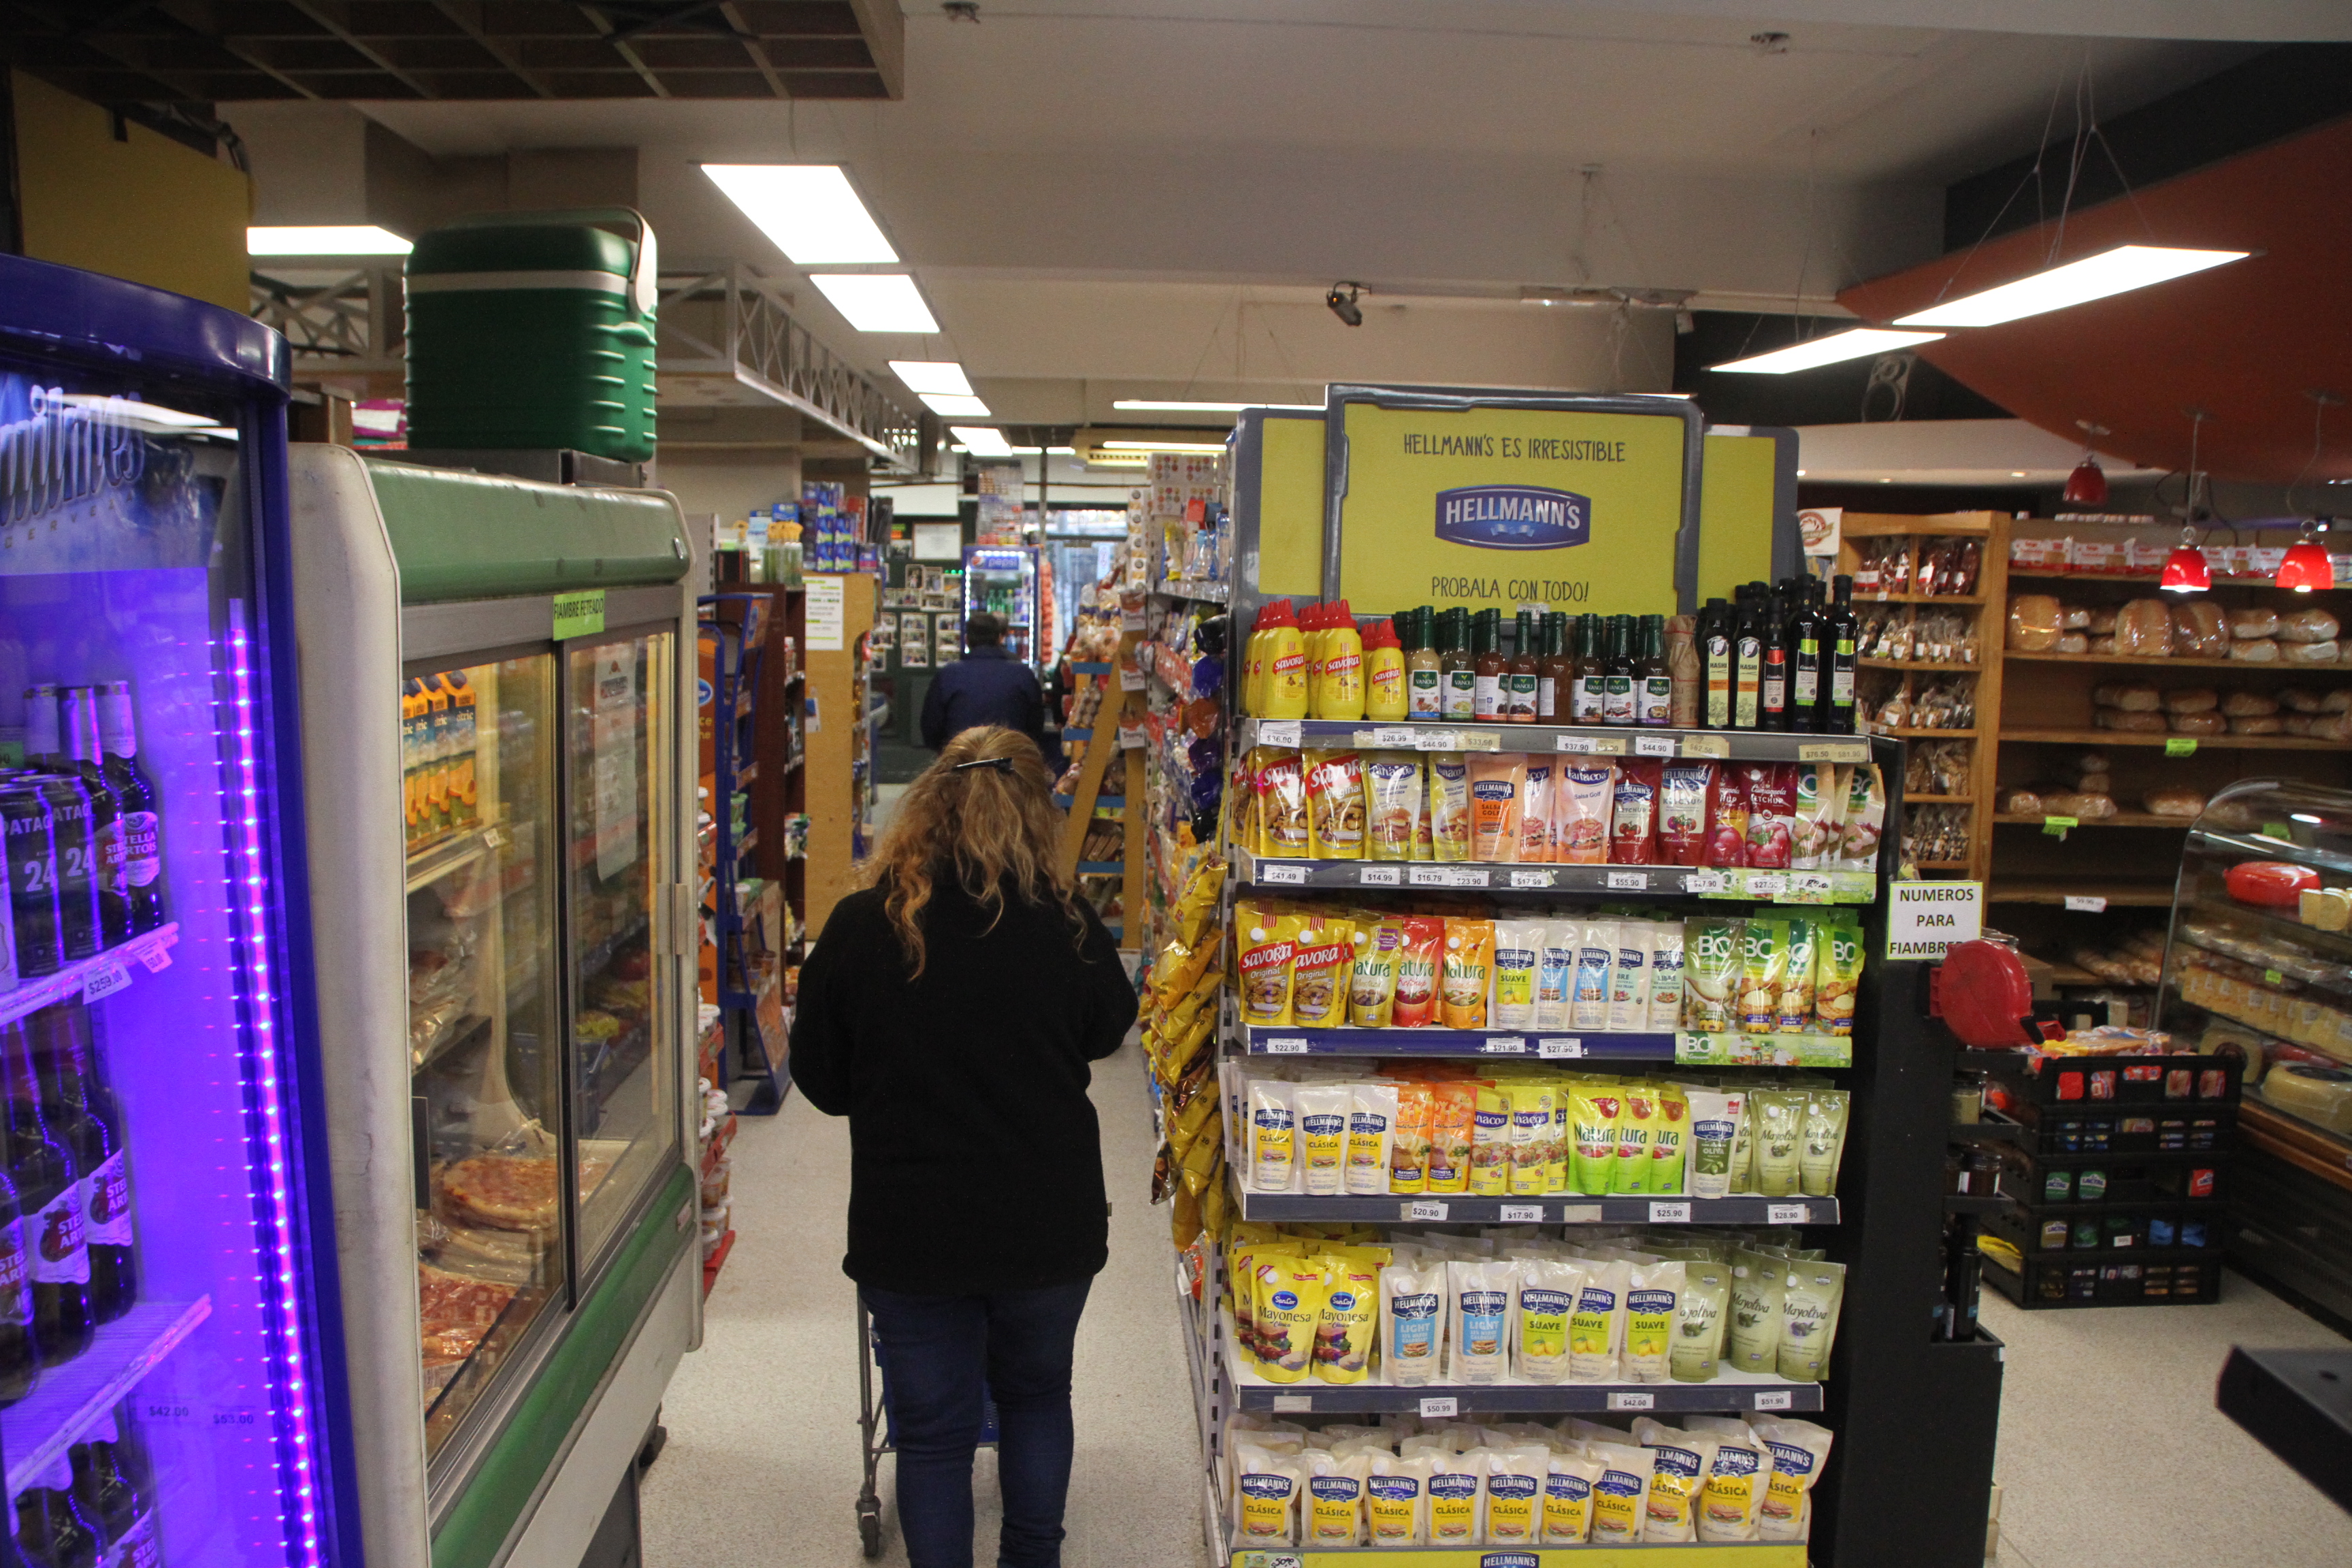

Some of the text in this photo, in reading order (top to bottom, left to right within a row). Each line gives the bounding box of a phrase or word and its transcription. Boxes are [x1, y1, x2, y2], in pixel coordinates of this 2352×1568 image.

[1403, 434, 1626, 463] HELLMANN'S ES IRRESISTIBLE
[1445, 497, 1580, 531] HELLMANN'S
[988, 558, 1018, 569] pepsi
[1431, 576, 1589, 603] PROBALA CON TODO!
[554, 598, 604, 620] FIAMBRE FETEADO
[1382, 734, 1407, 742] $26.99
[1565, 742, 1588, 751] $37.90
[1642, 743, 1667, 752] $44.90
[1806, 751, 1829, 759] $76.50
[1473, 784, 1512, 794] HELLMANN'S
[125, 831, 157, 846] TELLA
[127, 840, 157, 855] RTOIS
[1418, 874, 1442, 882] $16.79
[1615, 878, 1639, 887] $55.90
[1693, 879, 1717, 888] $27.90
[1899, 888, 1974, 902] NUMEROS
[1916, 914, 1956, 927] PARA
[1698, 934, 1732, 958] BC
[1745, 936, 1775, 960] BC
[1831, 940, 1857, 962] BC
[1496, 951, 1533, 962] HELLMANN'S
[1250, 966, 1281, 979] Original
[1296, 969, 1327, 981] Original
[1398, 977, 1427, 987] Ketchup
[1501, 975, 1526, 983] SUAVE
[1275, 1044, 1300, 1052] $22.90
[1493, 1044, 1518, 1052] $21.90
[1547, 1045, 1573, 1054] $27.90
[1686, 1036, 1711, 1054] BC
[1257, 1111, 1294, 1122] HELLMANN'S
[1305, 1116, 1343, 1128] HELLMANN'S
[1697, 1124, 1733, 1133] HELLMANN'S
[1413, 1207, 1439, 1217] $20.90
[1507, 1211, 1533, 1220] $17.90
[1657, 1209, 1682, 1217] $25.90
[1775, 1211, 1798, 1220] $28.90
[1275, 1296, 1296, 1305] SanCor
[1394, 1296, 1437, 1309] HELLMANN'S
[1463, 1294, 1506, 1305] HELLMANN'S
[1523, 1293, 1570, 1307] HELLMANN'S
[1629, 1293, 1673, 1305] HELLMANN'S
[1259, 1305, 1311, 1324] Mayonesa
[1783, 1302, 1828, 1323] Mayoliva
[1400, 1322, 1431, 1333] LIGHT
[1469, 1320, 1500, 1330] LIGHT
[1529, 1320, 1561, 1331] SUAVE
[1572, 1318, 1603, 1329] SUAVE
[1635, 1321, 1665, 1330] SUAVE
[1623, 1399, 1647, 1407] $42.00
[1761, 1396, 1784, 1405] $51.90
[1426, 1404, 1451, 1413] $50.99
[1243, 1477, 1290, 1491] HELLMANN'S
[1312, 1480, 1358, 1493] HELLMANN'S
[1370, 1479, 1417, 1492] HELLMANN'S
[1431, 1476, 1477, 1490] HELLMANN'S
[1490, 1477, 1535, 1490] HELLMANN'S
[1546, 1477, 1588, 1492] HELLMANN'S
[1246, 1503, 1282, 1515] CLÁSICA
[1374, 1505, 1411, 1516] CLÁSICA
[1435, 1504, 1471, 1515] CLÁSICA
[1493, 1503, 1529, 1515] CLÁSICA
[1546, 1504, 1582, 1516] CLÁSICA
[1597, 1498, 1632, 1513] CLÁSICA
[1316, 1506, 1352, 1517] CLÁSICA
[1484, 1555, 1536, 1568] HELLMANN'S
